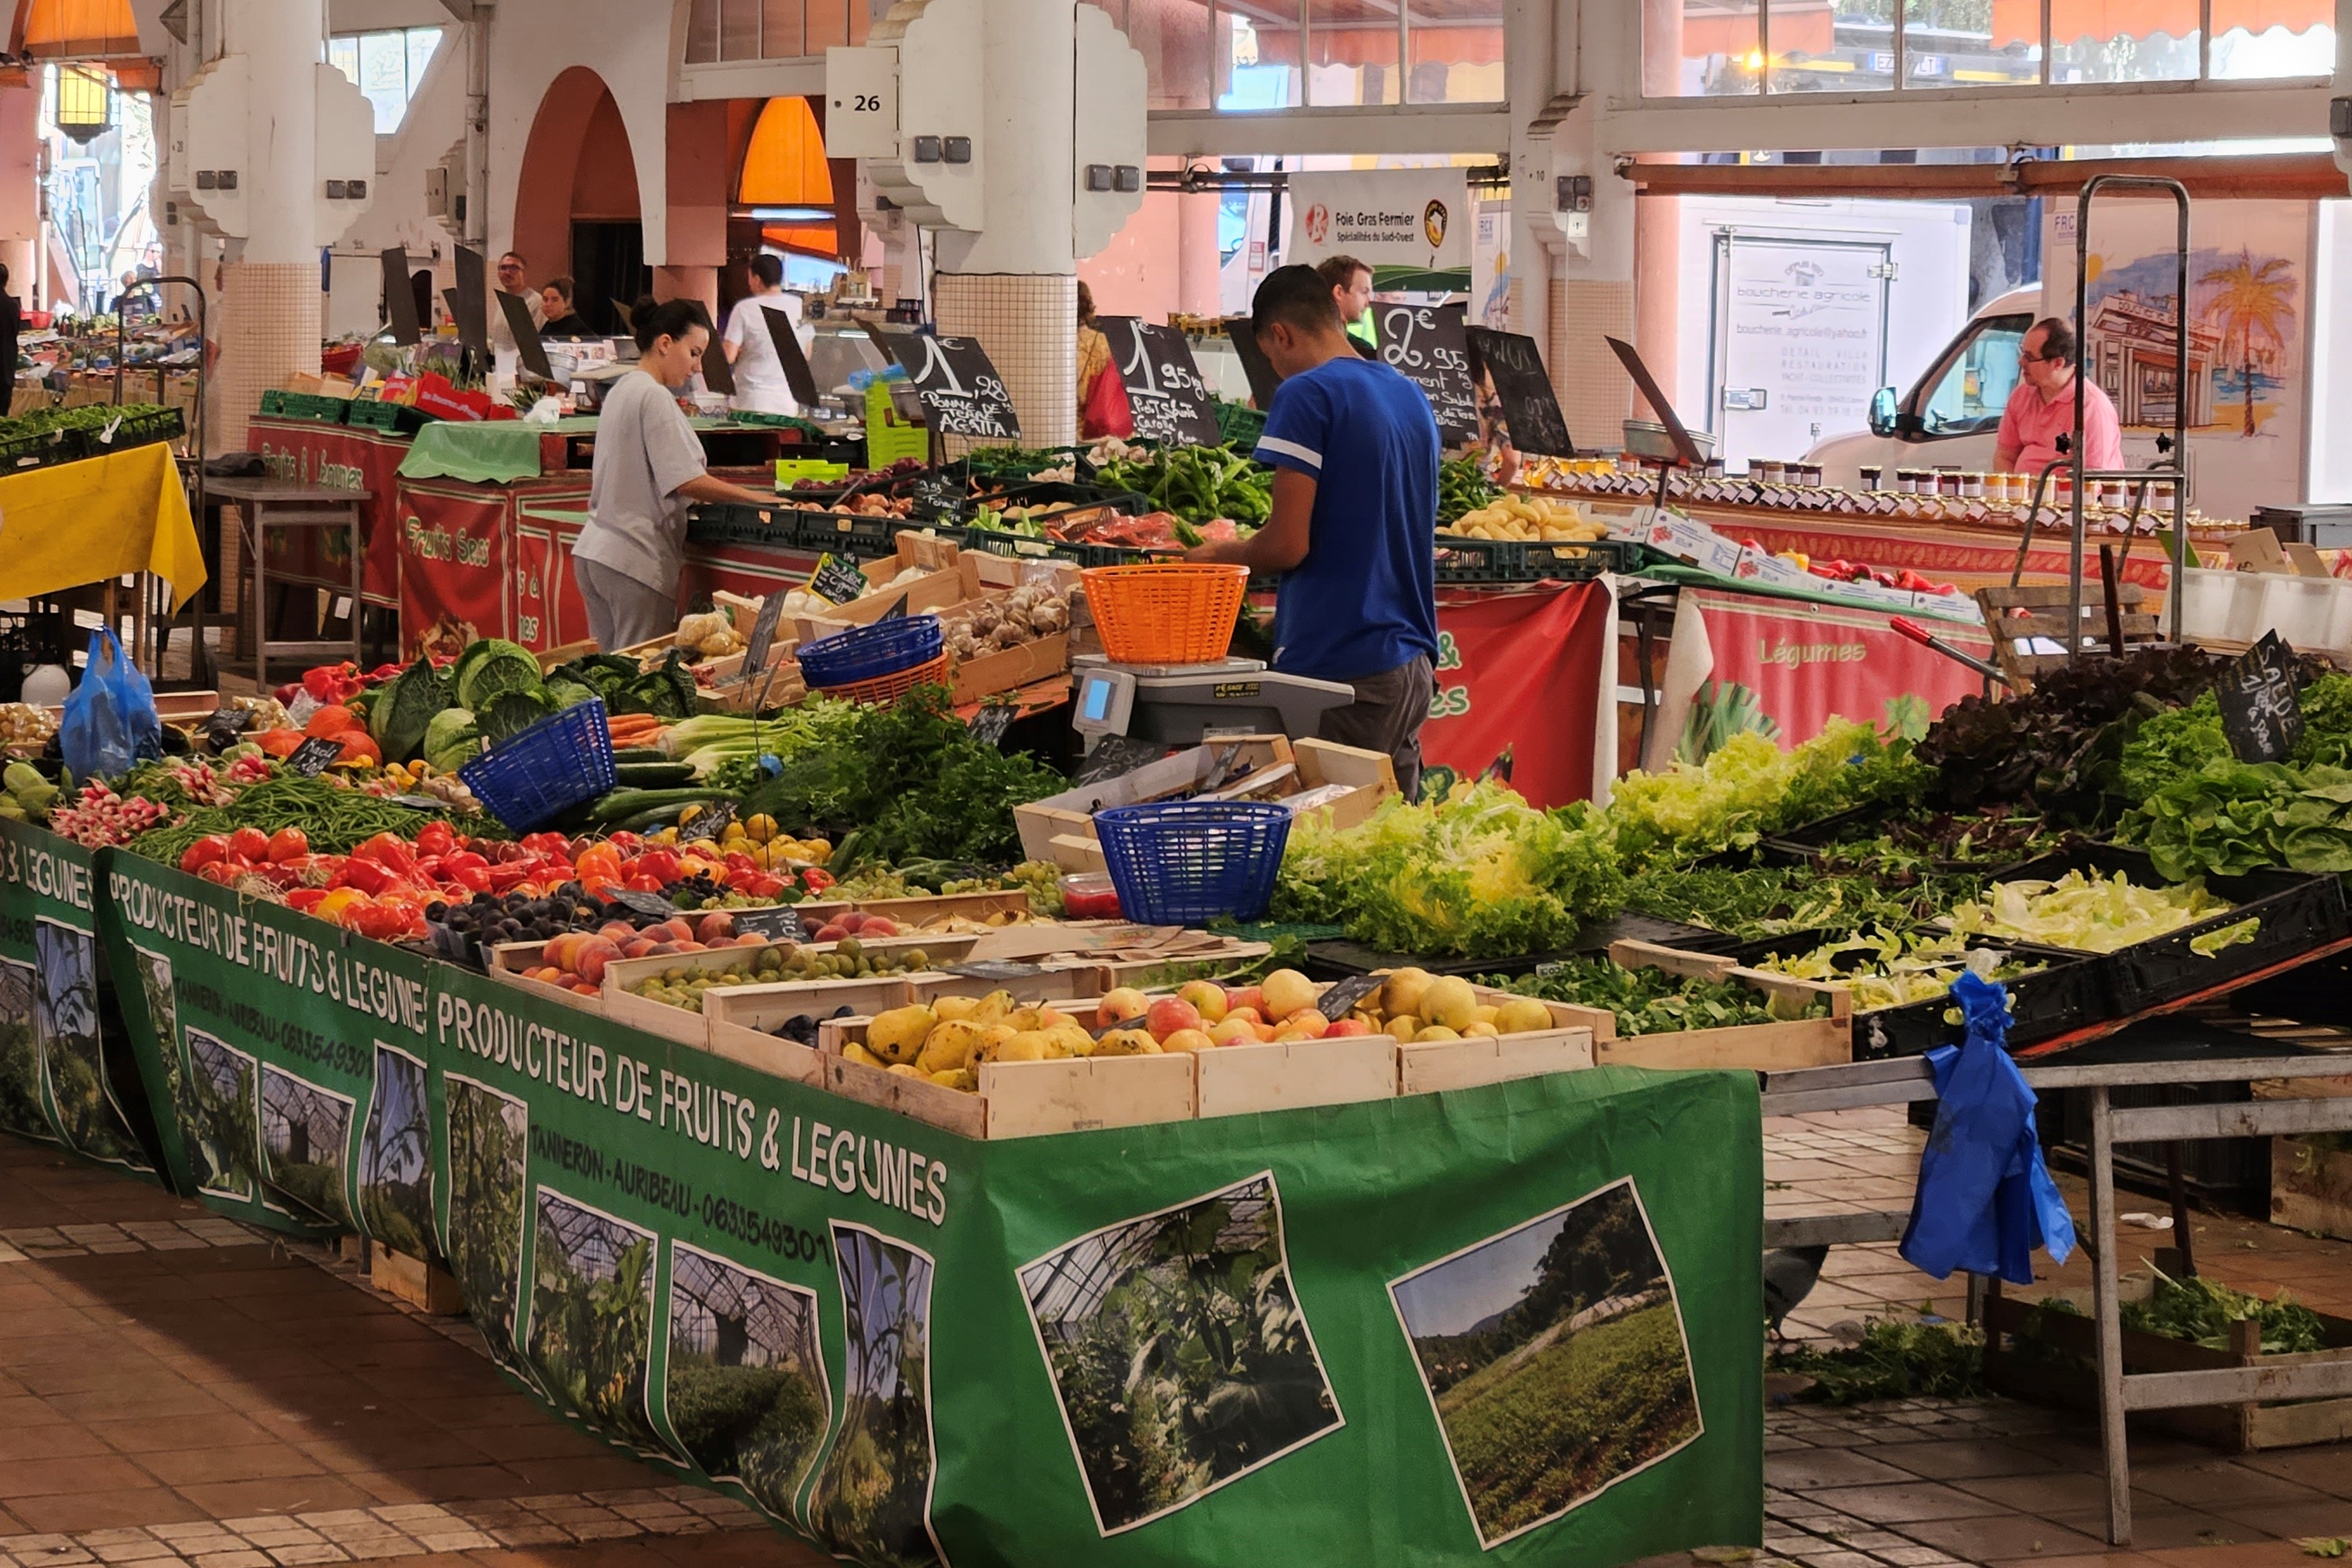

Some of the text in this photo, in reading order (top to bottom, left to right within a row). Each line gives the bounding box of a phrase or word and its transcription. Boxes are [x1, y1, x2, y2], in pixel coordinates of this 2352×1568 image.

[855, 95, 881, 112] 26
[1537, 170, 1545, 182] 10
[1336, 212, 1415, 227] Foie Gras Fermier
[1381, 231, 1415, 242] Sud-Ouest
[1737, 287, 1871, 303] boucherie agricole
[1435, 631, 1463, 670] &
[1758, 637, 1867, 670] Légumes
[109, 872, 222, 957] PRODUCTEUR
[223, 913, 250, 966] DE
[253, 921, 325, 994] FRUITS
[327, 950, 342, 1001] &
[438, 992, 947, 1227] PRODUCTEUR DE FRUITS & LEGUMES
[530, 1124, 604, 1175] TANNERON
[613, 1158, 692, 1218] AURIBEAU
[703, 1193, 832, 1267] 0633549301
